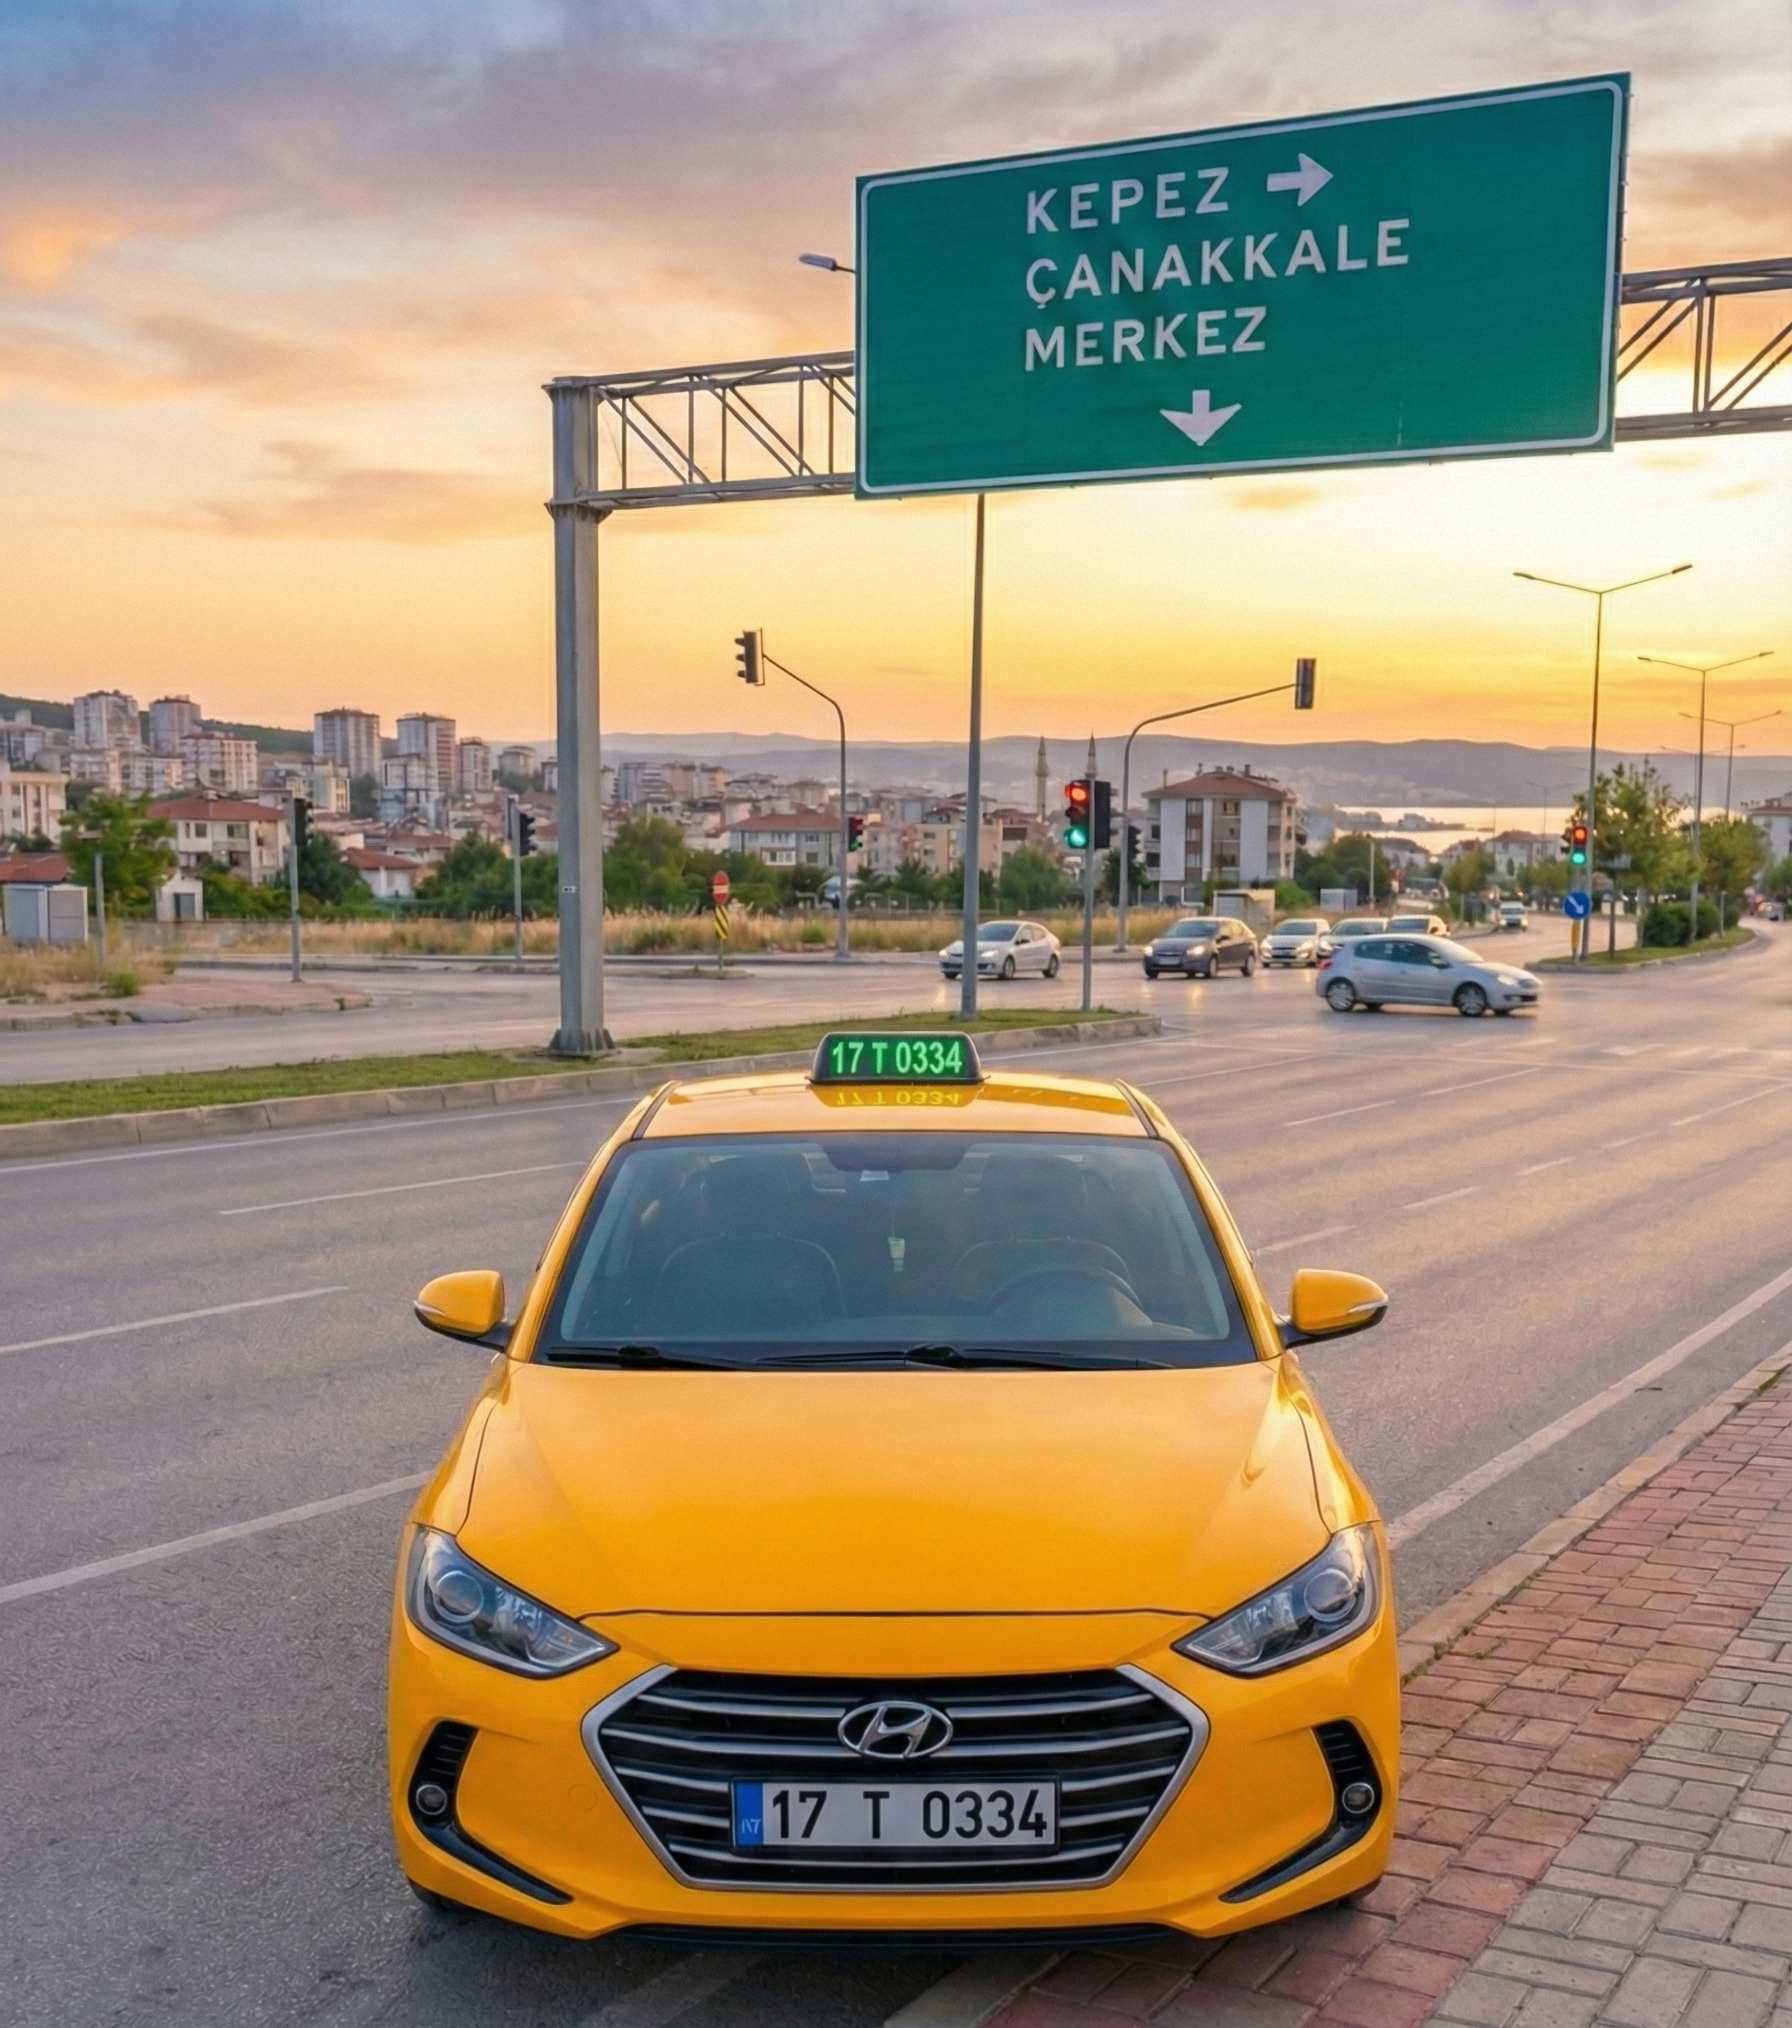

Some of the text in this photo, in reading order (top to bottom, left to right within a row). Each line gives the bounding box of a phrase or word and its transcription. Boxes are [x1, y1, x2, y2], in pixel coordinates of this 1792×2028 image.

[1026, 167, 1229, 234] KEPEZ
[1025, 218, 1410, 309] ÇANAKKALE
[1025, 306, 1267, 371] MERKEZ
[832, 1041, 963, 1074] 17 T 0334
[772, 1789, 1048, 1840] 17 T 0334
